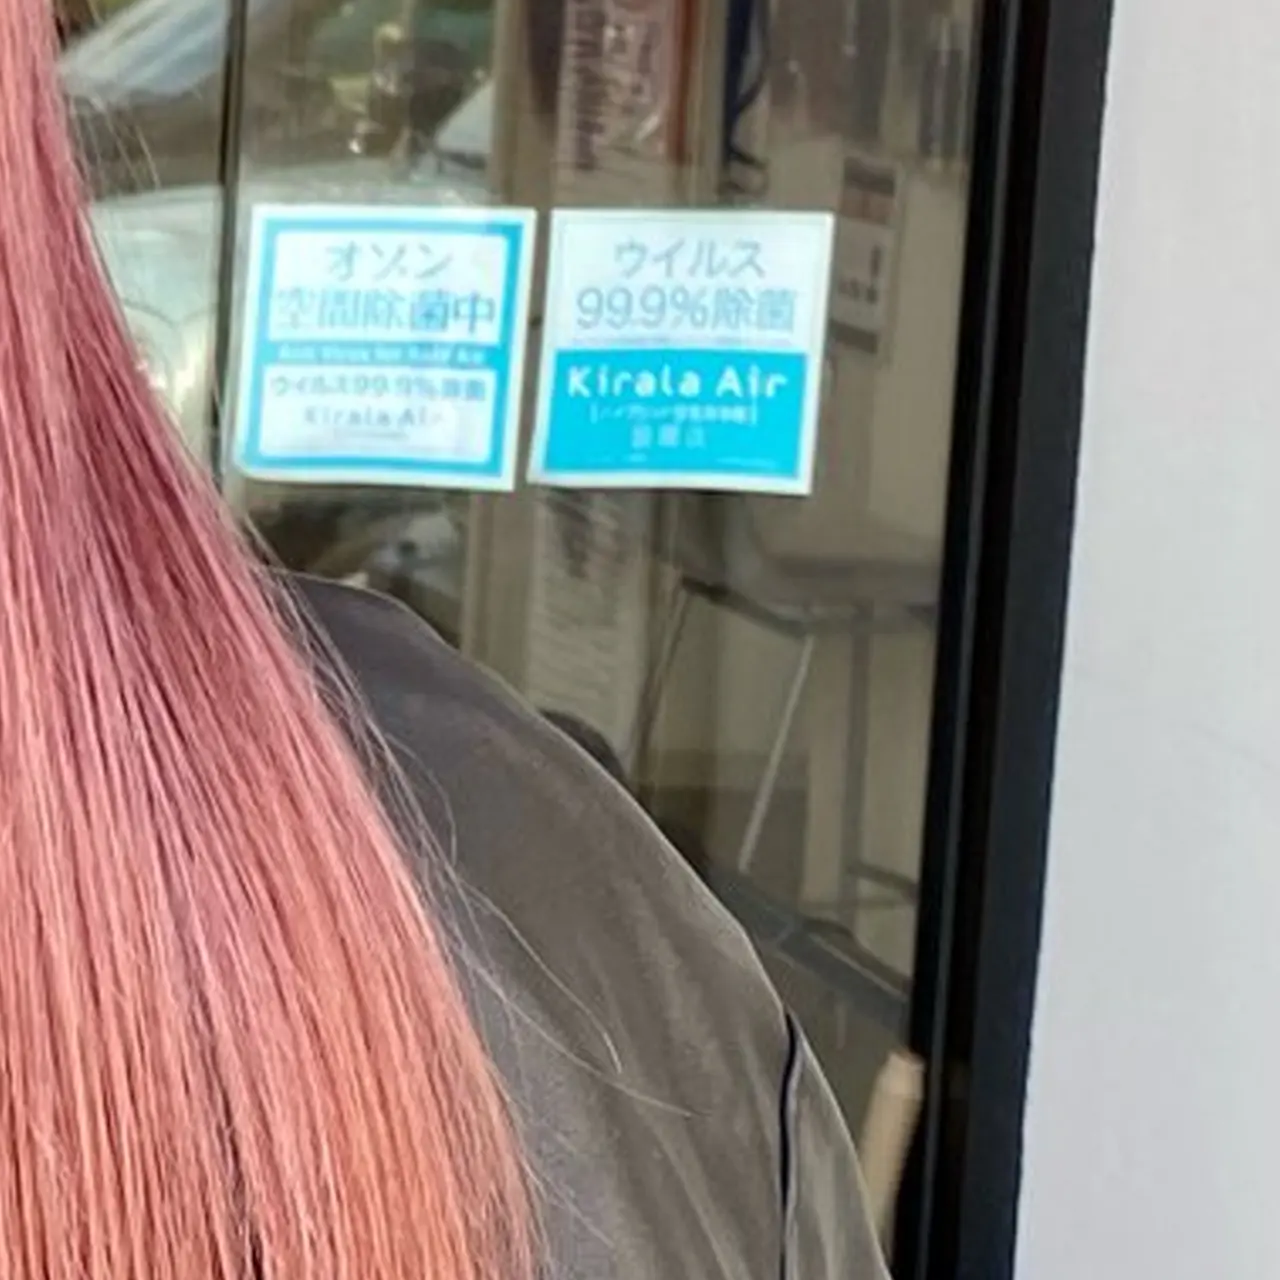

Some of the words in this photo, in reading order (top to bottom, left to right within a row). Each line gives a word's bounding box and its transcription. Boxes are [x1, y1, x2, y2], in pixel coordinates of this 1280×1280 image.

[325, 240, 454, 282] オゾン
[613, 236, 767, 279] ウイルス
[275, 286, 497, 335] 空間除菌中
[576, 285, 798, 334] 99.9%除菌
[567, 363, 702, 399] Kirala
[715, 363, 789, 399] Air
